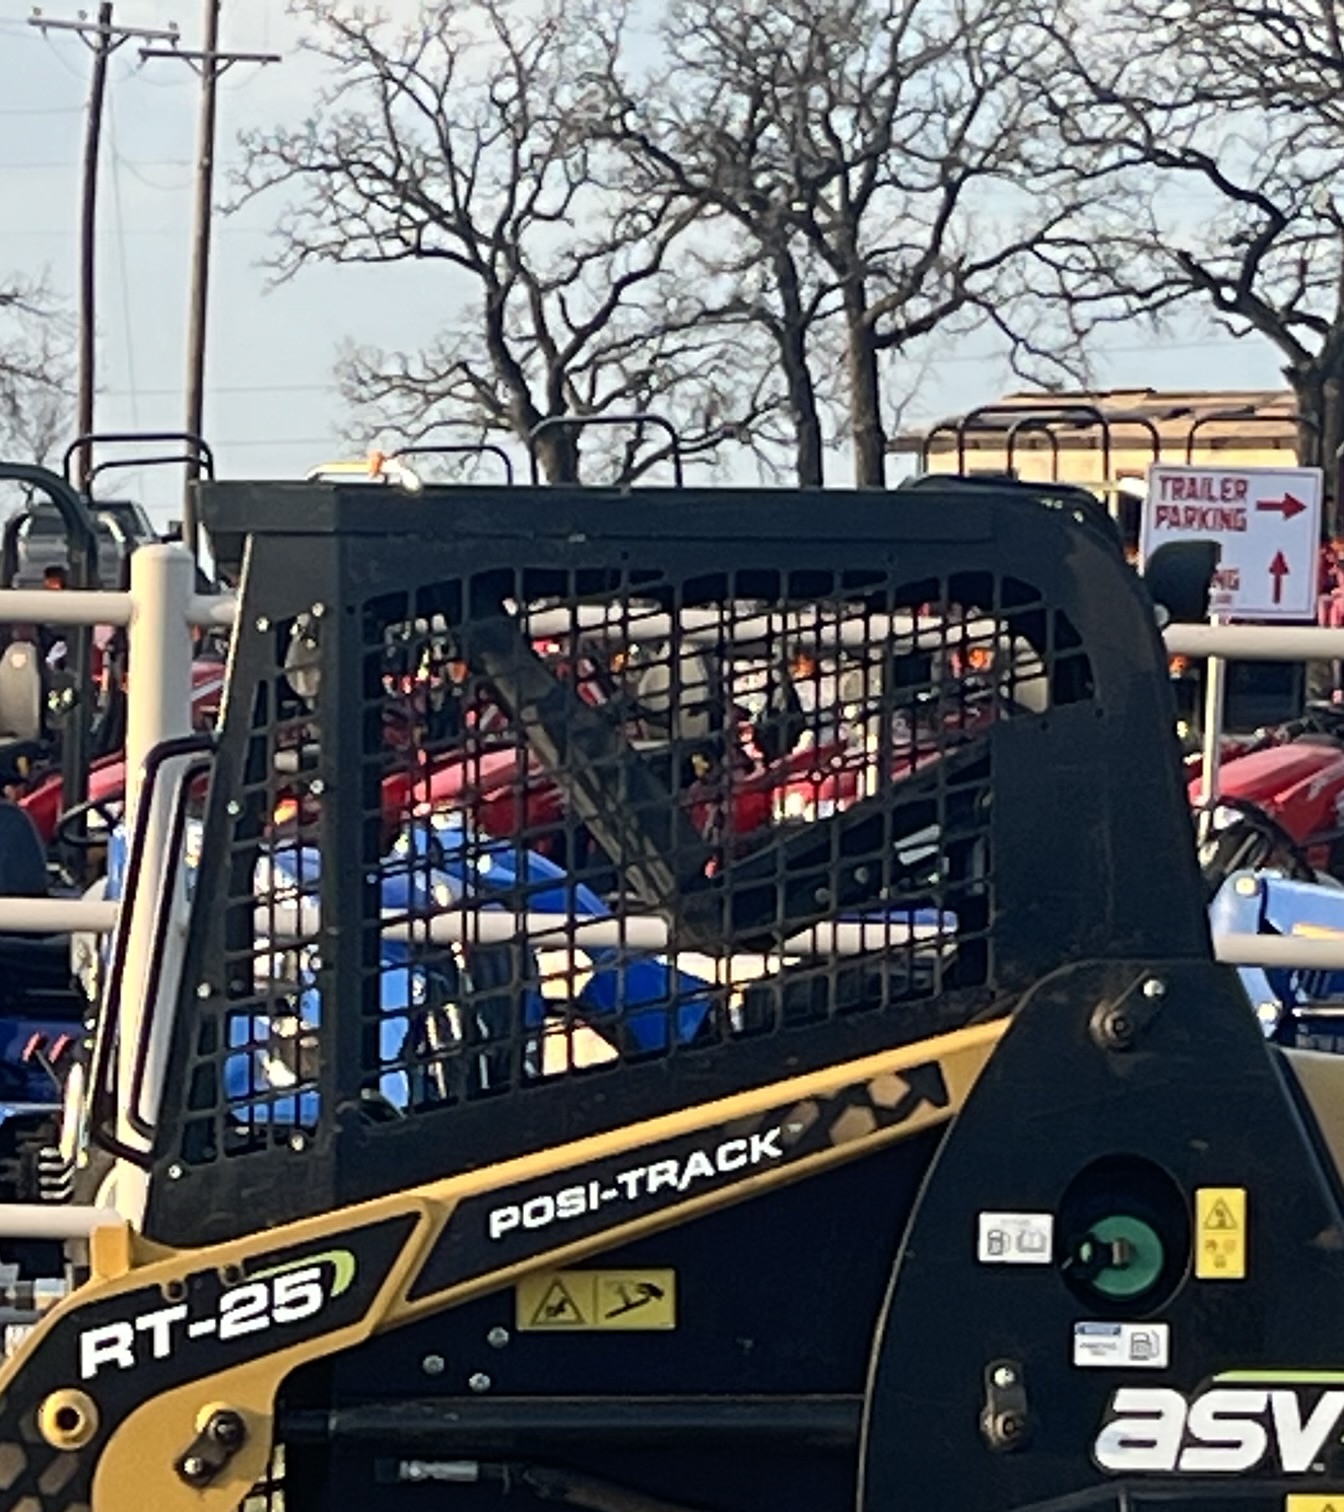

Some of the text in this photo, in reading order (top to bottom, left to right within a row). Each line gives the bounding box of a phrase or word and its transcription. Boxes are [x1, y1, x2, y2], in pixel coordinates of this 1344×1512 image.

[1154, 504, 1248, 532] PARKING
[1159, 476, 1248, 502] TRAILER
[489, 1125, 784, 1240] POSI-TRACK
[80, 1267, 324, 1380] RT-25
